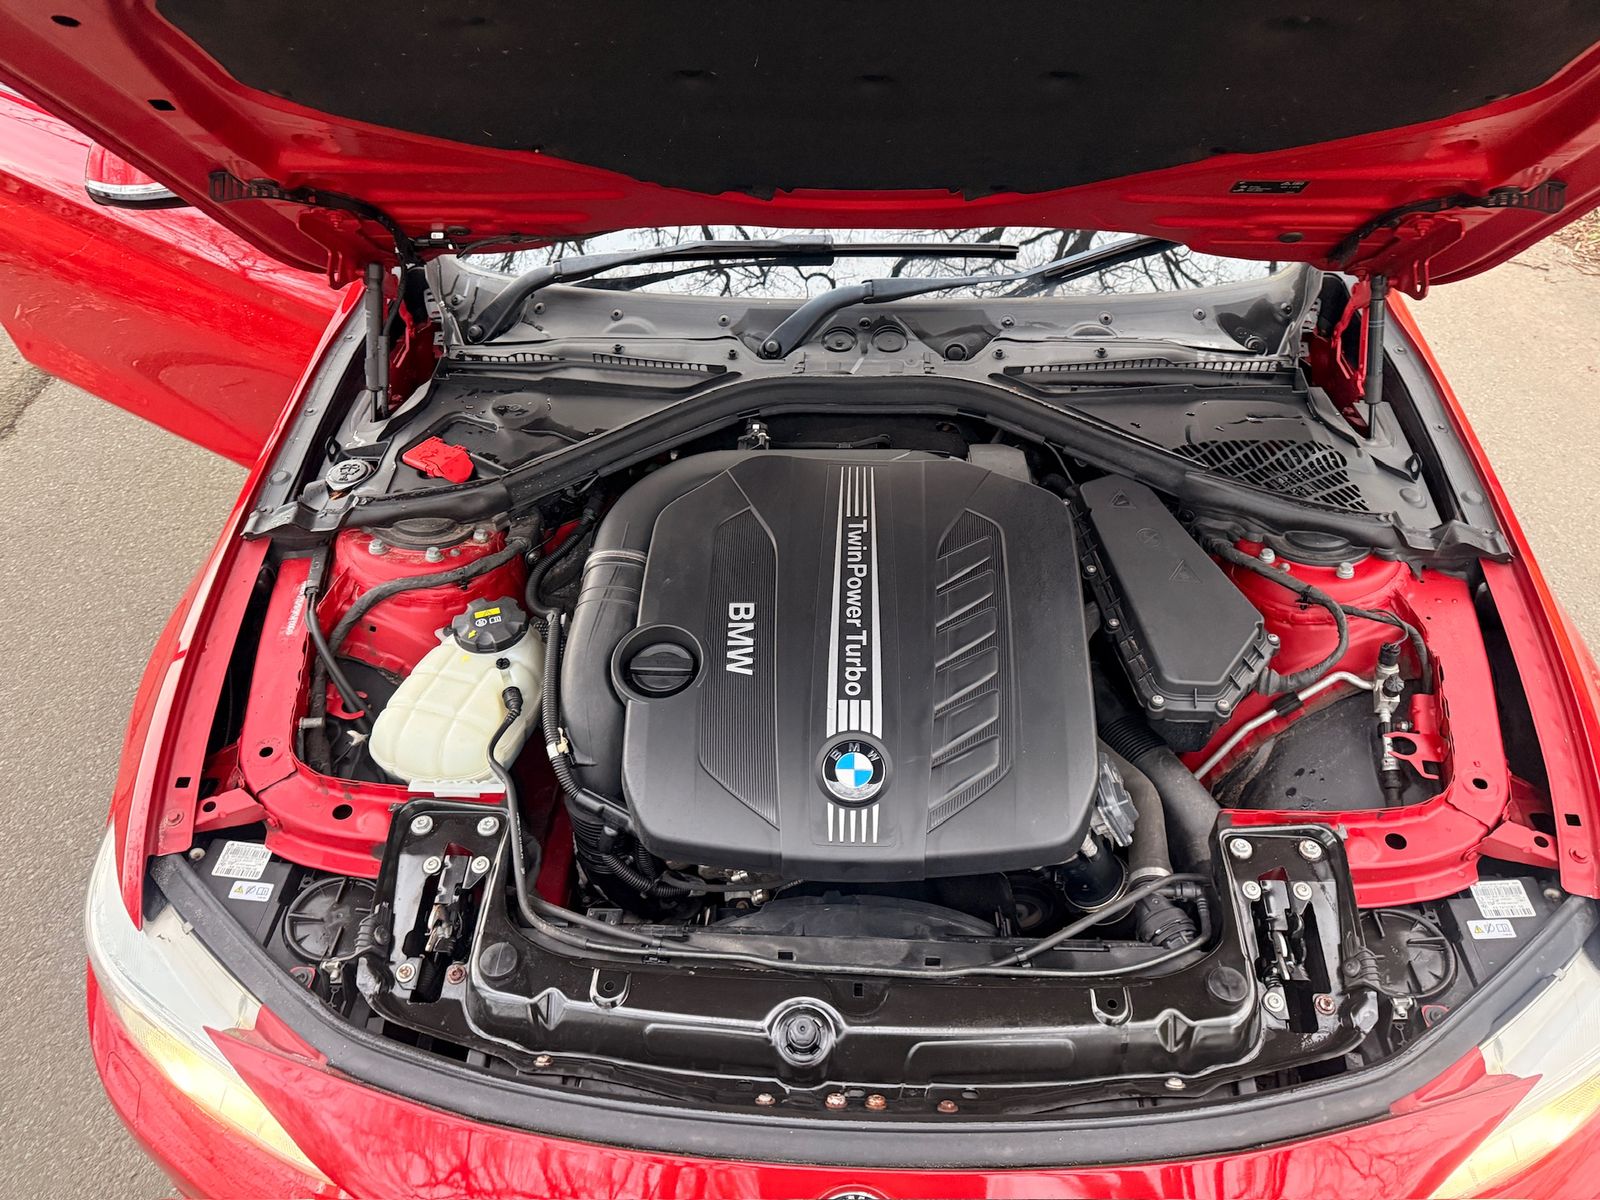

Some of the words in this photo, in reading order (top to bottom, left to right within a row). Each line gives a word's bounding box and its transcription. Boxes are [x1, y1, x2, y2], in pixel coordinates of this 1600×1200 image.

[846, 519, 868, 627] TwinPower
[726, 602, 755, 676] BMW
[844, 629, 867, 696] Turbo
[830, 743, 880, 761] BMW
